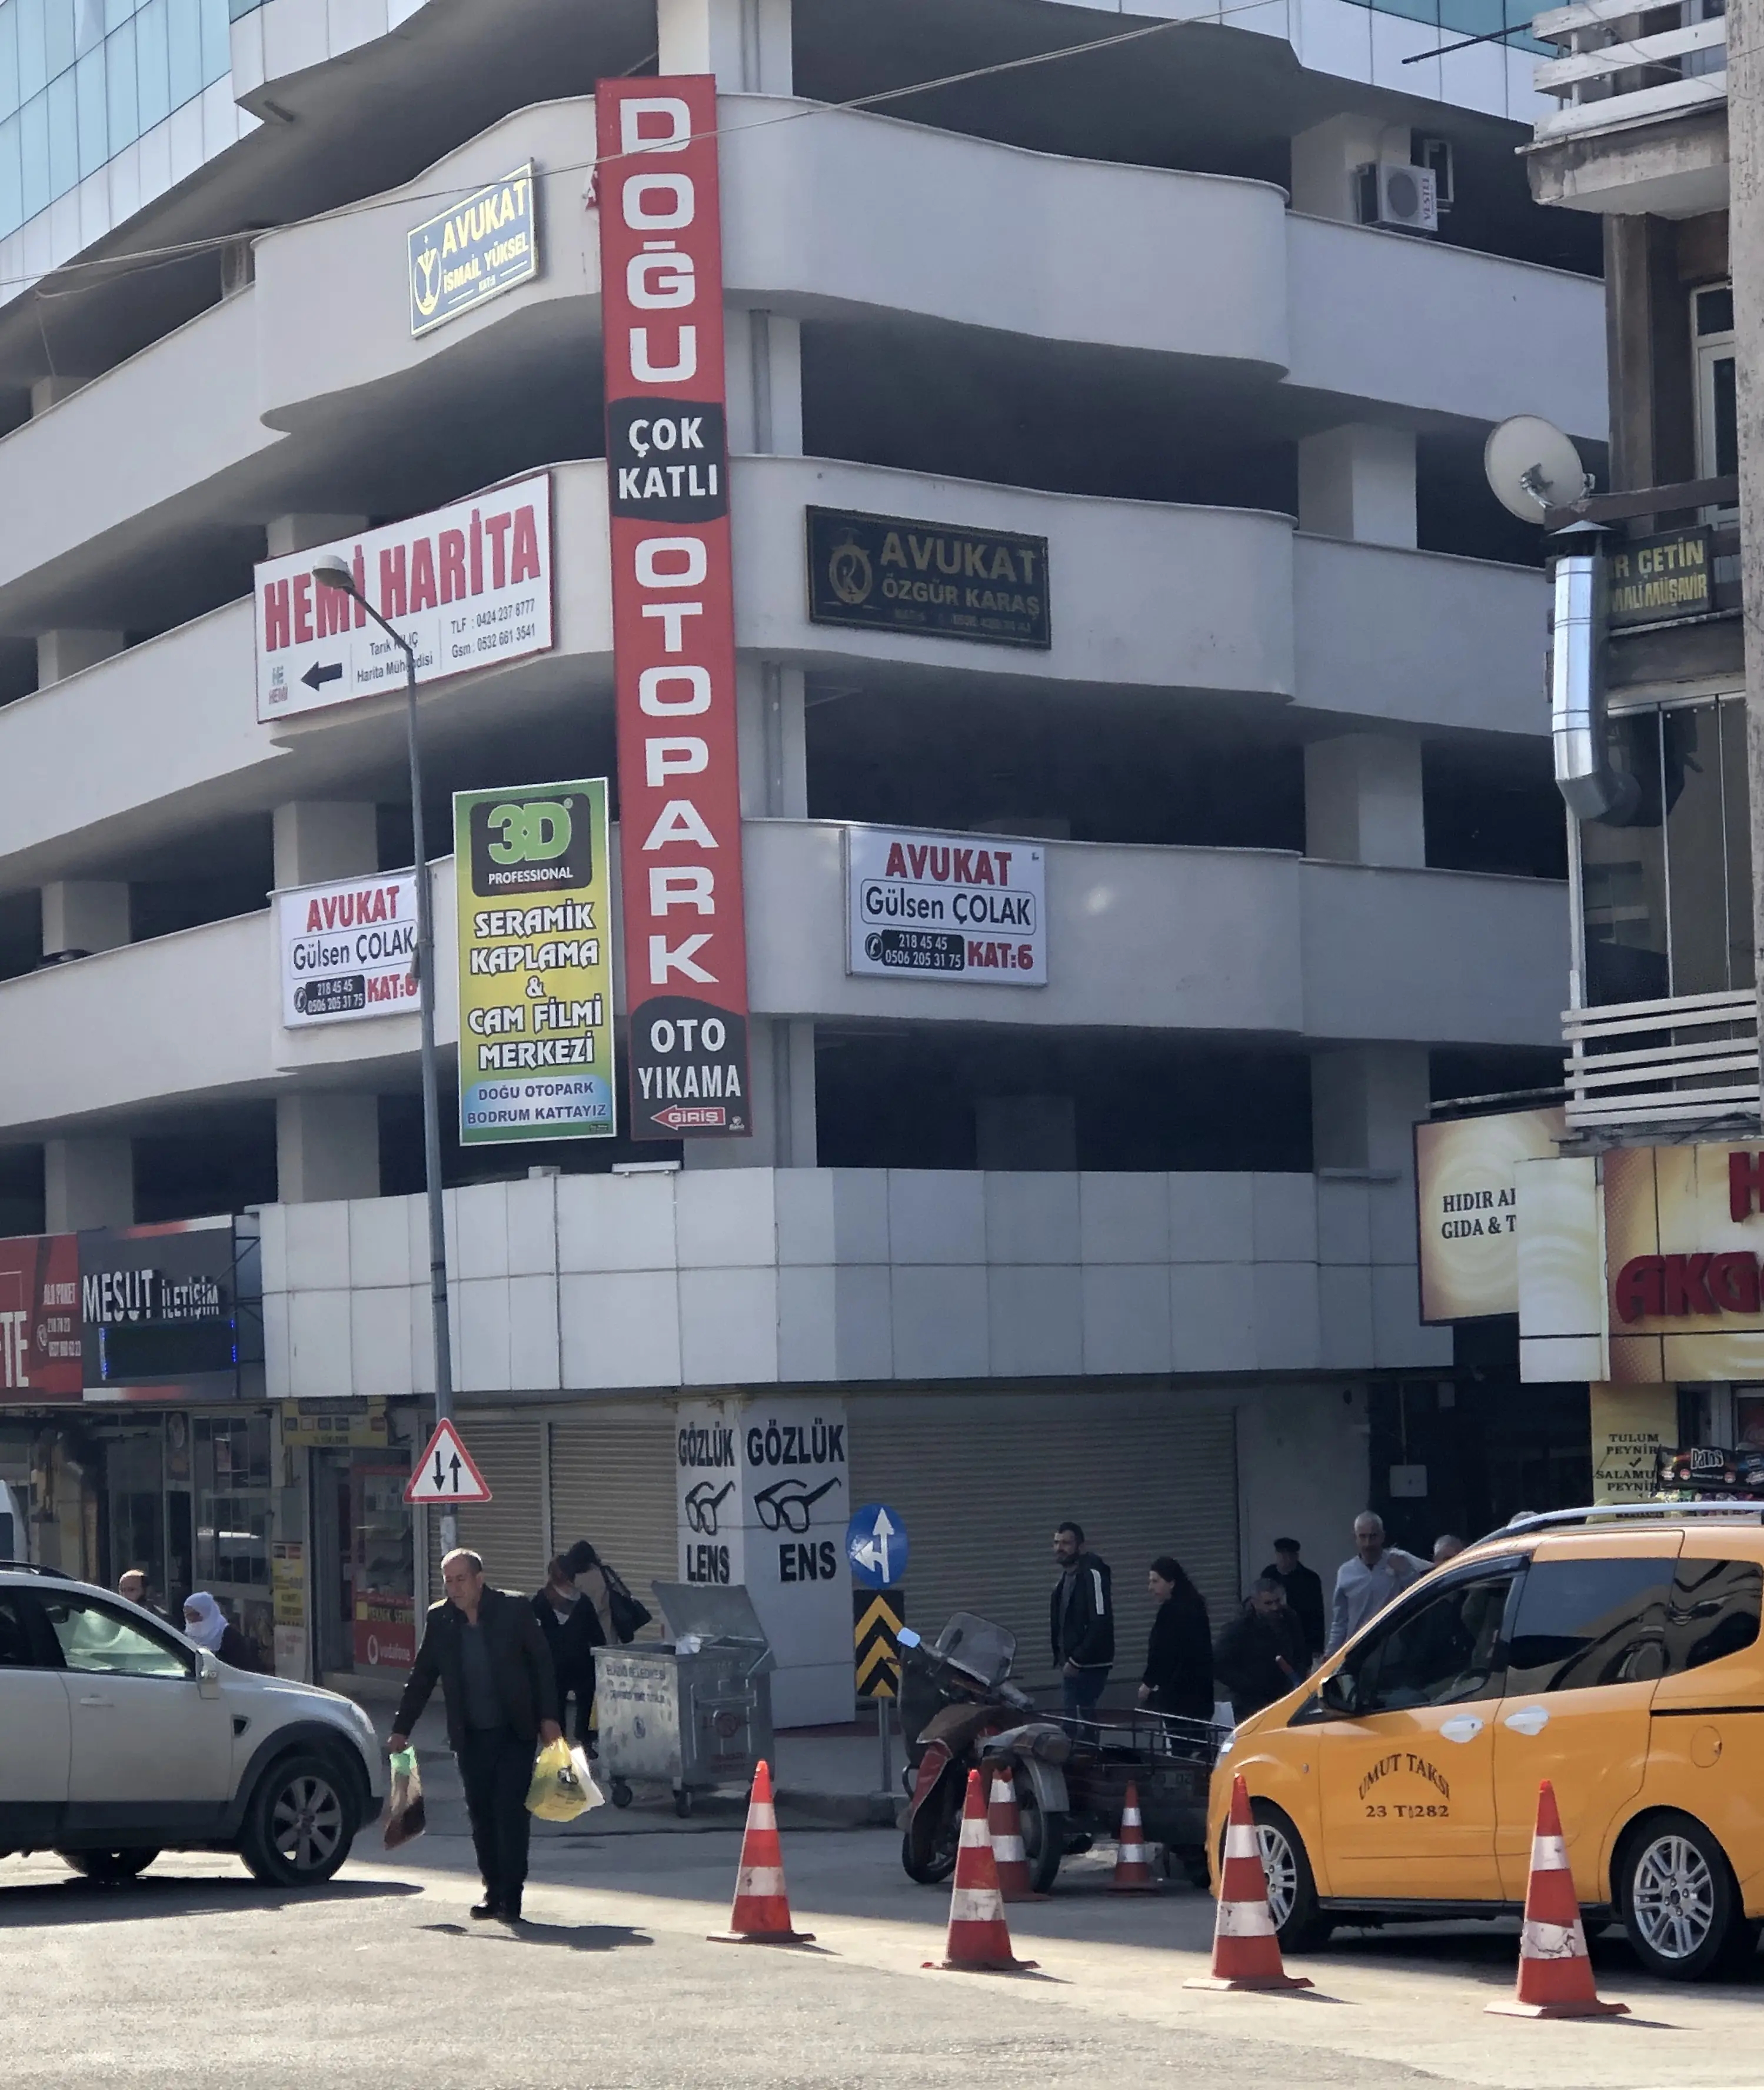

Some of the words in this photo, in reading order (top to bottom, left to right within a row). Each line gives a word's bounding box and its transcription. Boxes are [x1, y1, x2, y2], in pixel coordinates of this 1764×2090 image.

[442, 179, 527, 258] AVUKAT
[620, 98, 697, 382] DOĞU
[443, 254, 481, 294] İSMAİL
[483, 232, 529, 271] YÜKSEL
[629, 417, 704, 457] ÇOK
[618, 464, 718, 499] KATLI
[379, 505, 541, 620] HARİTA
[881, 533, 1036, 585] AVUKAT
[1638, 537, 1703, 578] ÇETİN
[883, 573, 959, 607] ÖZGÜR
[966, 588, 1040, 620] KARAŞ
[1645, 572, 1707, 607] MÜŞAVİR
[451, 617, 466, 634] TLF
[477, 614, 496, 627] 0424
[498, 605, 512, 621] 237
[515, 598, 535, 616] 8777
[477, 633, 497, 651] 0532
[499, 630, 513, 645] 661
[517, 623, 535, 641] 3541
[357, 665, 384, 683] Harita
[635, 537, 719, 984] OTOPARK
[488, 801, 573, 865] 3D
[488, 866, 574, 885] PROFESSIONAL
[886, 843, 1012, 886] AVUKAT
[307, 885, 400, 933] AVUKAT
[474, 898, 595, 938] SERAMİK
[866, 887, 944, 920] Gülsen
[953, 893, 1031, 925] ÇOLAK
[356, 927, 416, 964] ÇOLAK
[470, 938, 600, 975] KAPLAMA
[886, 950, 910, 964] 0506
[913, 952, 931, 966] 205
[934, 953, 946, 967] 31
[949, 954, 961, 968] 75
[899, 934, 917, 949] 218
[920, 936, 933, 950] 45
[936, 937, 948, 950] 45
[968, 941, 1034, 970] KAT:6
[308, 999, 326, 1013] 0506
[328, 997, 341, 1010] 205
[342, 996, 351, 1008] 31
[354, 993, 363, 1007] 75
[317, 982, 331, 996] 218
[332, 981, 342, 993] 45
[344, 979, 353, 991] 45
[367, 973, 419, 1003] KAT:6
[526, 976, 546, 999] &
[469, 1004, 525, 1037] CAM
[534, 993, 603, 1034] FİLMİ
[478, 1031, 594, 1071] MERKEZİ
[650, 1018, 726, 1053] OTO
[478, 1084, 520, 1101] DOĞU
[525, 1081, 594, 1099] OTOPARK
[638, 1065, 741, 1099] YIKAMA
[468, 1109, 530, 1124] BODRUM
[535, 1104, 607, 1121] KATTAYIZ
[1443, 1191, 1493, 1213] HIDIR
[1729, 1152, 1764, 1223] H
[1442, 1219, 1484, 1239] GIDA
[1488, 1216, 1502, 1234] &
[82, 1269, 154, 1323] MESUT
[161, 1275, 220, 1320] İLETİŞİM
[1616, 1251, 1764, 1324] AKG
[0, 1311, 29, 1388] TE
[678, 1421, 735, 1467] GÖZLÜK
[747, 1417, 846, 1466] GÖZLÜK
[1608, 1434, 1659, 1442] TULUM
[687, 1545, 730, 1585] LENS
[779, 1541, 837, 1583] ENS
[1359, 1753, 1402, 1801] UMUT
[1366, 1805, 1387, 1818] 23
